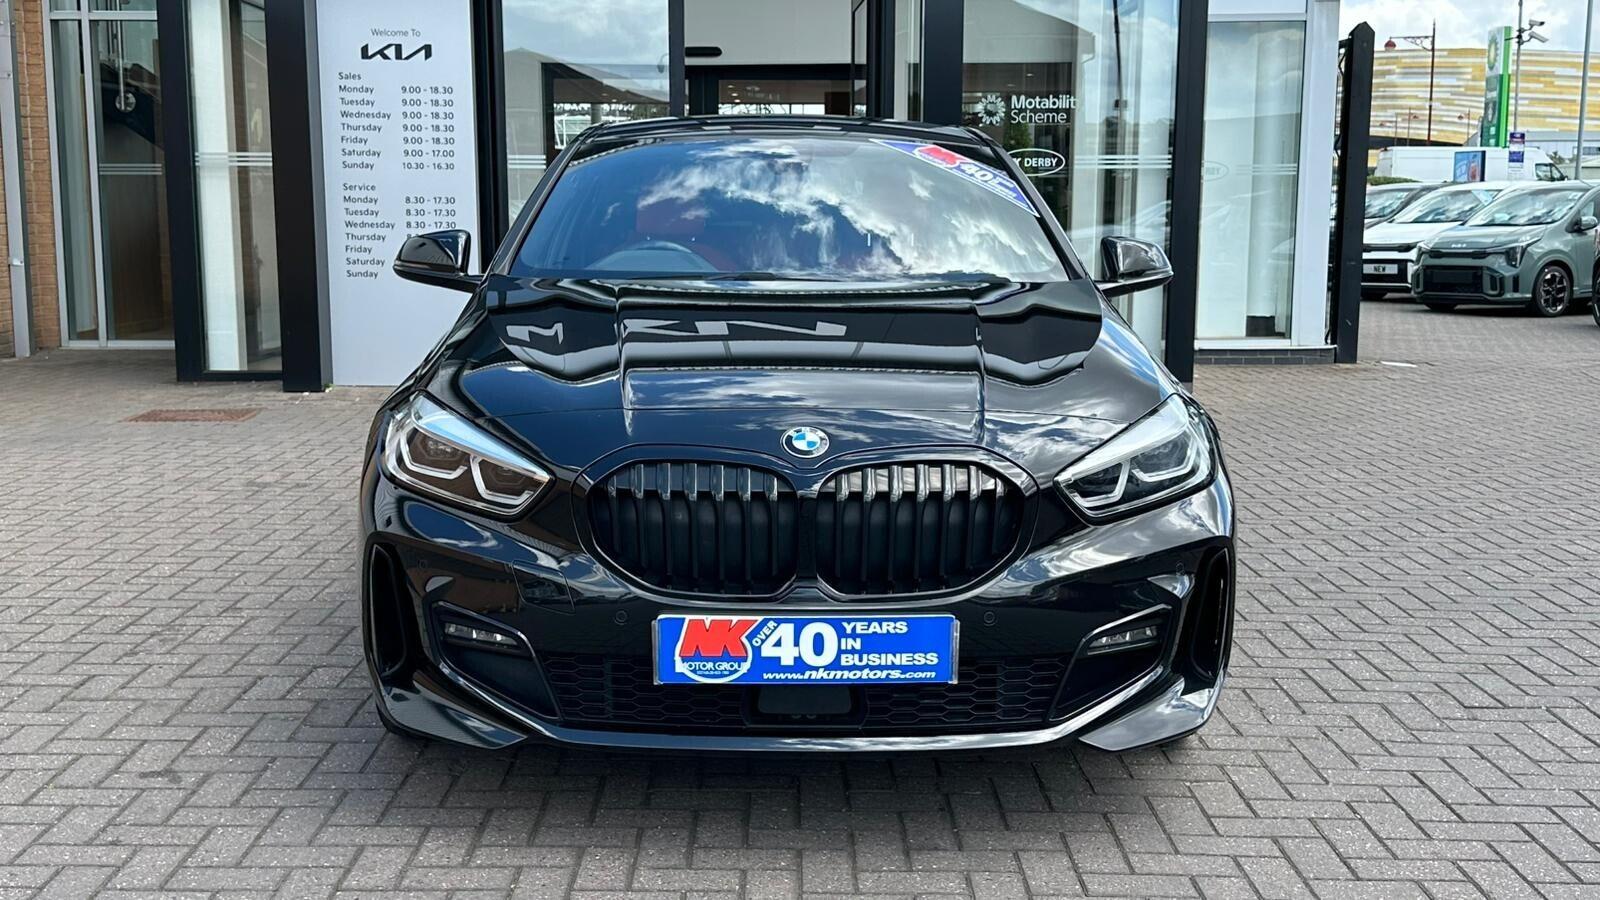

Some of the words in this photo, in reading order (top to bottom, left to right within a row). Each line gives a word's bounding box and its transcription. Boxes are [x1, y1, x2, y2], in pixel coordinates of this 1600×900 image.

[370, 28, 409, 38] Welcome
[410, 27, 422, 38] To
[361, 43, 432, 61] KIA
[337, 71, 362, 81] Sales
[338, 84, 375, 95] Monday
[400, 85, 422, 95] 9.00
[429, 85, 454, 95] 18.30
[339, 96, 376, 108] Tuesday
[401, 97, 422, 108] 9.00
[429, 98, 454, 108] 18.30
[1011, 94, 1080, 112] Motabilit
[339, 110, 392, 121] Wednesday
[401, 110, 423, 120] 9.00
[430, 111, 455, 121] 18.30
[1011, 109, 1067, 124] Scheme
[340, 122, 383, 134] Thursday
[402, 123, 423, 133] 9.00
[430, 123, 455, 133] 18.30
[340, 135, 369, 146] Friday
[402, 136, 424, 146] 9.00
[431, 136, 456, 146] 18.30
[341, 147, 382, 159] Saturday
[403, 148, 424, 158] 9.00
[431, 149, 455, 158] 17.00
[341, 160, 375, 171] Sunday
[402, 161, 425, 170] 10.30
[432, 162, 455, 171] 16.30
[1024, 157, 1058, 167] DERBY
[961, 163, 994, 182] 40
[342, 182, 377, 192] Service
[343, 195, 379, 206] Monday
[404, 195, 426, 205] 8.30
[432, 196, 456, 205] 17.30
[343, 207, 380, 218] Tuesday
[405, 208, 426, 217] 8.30
[433, 208, 457, 218] 17.30
[344, 219, 396, 231] Wednesday
[405, 220, 426, 230] 8.30
[433, 220, 457, 230] 17.30
[344, 232, 387, 243] Thursday
[344, 244, 373, 255] Friday
[345, 256, 386, 268] Saturday
[345, 269, 379, 280] Sunday
[752, 620, 778, 647] OVER
[842, 621, 908, 635] YEARS
[679, 618, 758, 657] NK
[761, 622, 839, 667] 40
[840, 638, 862, 650] IN
[840, 653, 939, 666] BUSINESS
[762, 668, 936, 680] www.nkmotors.com
